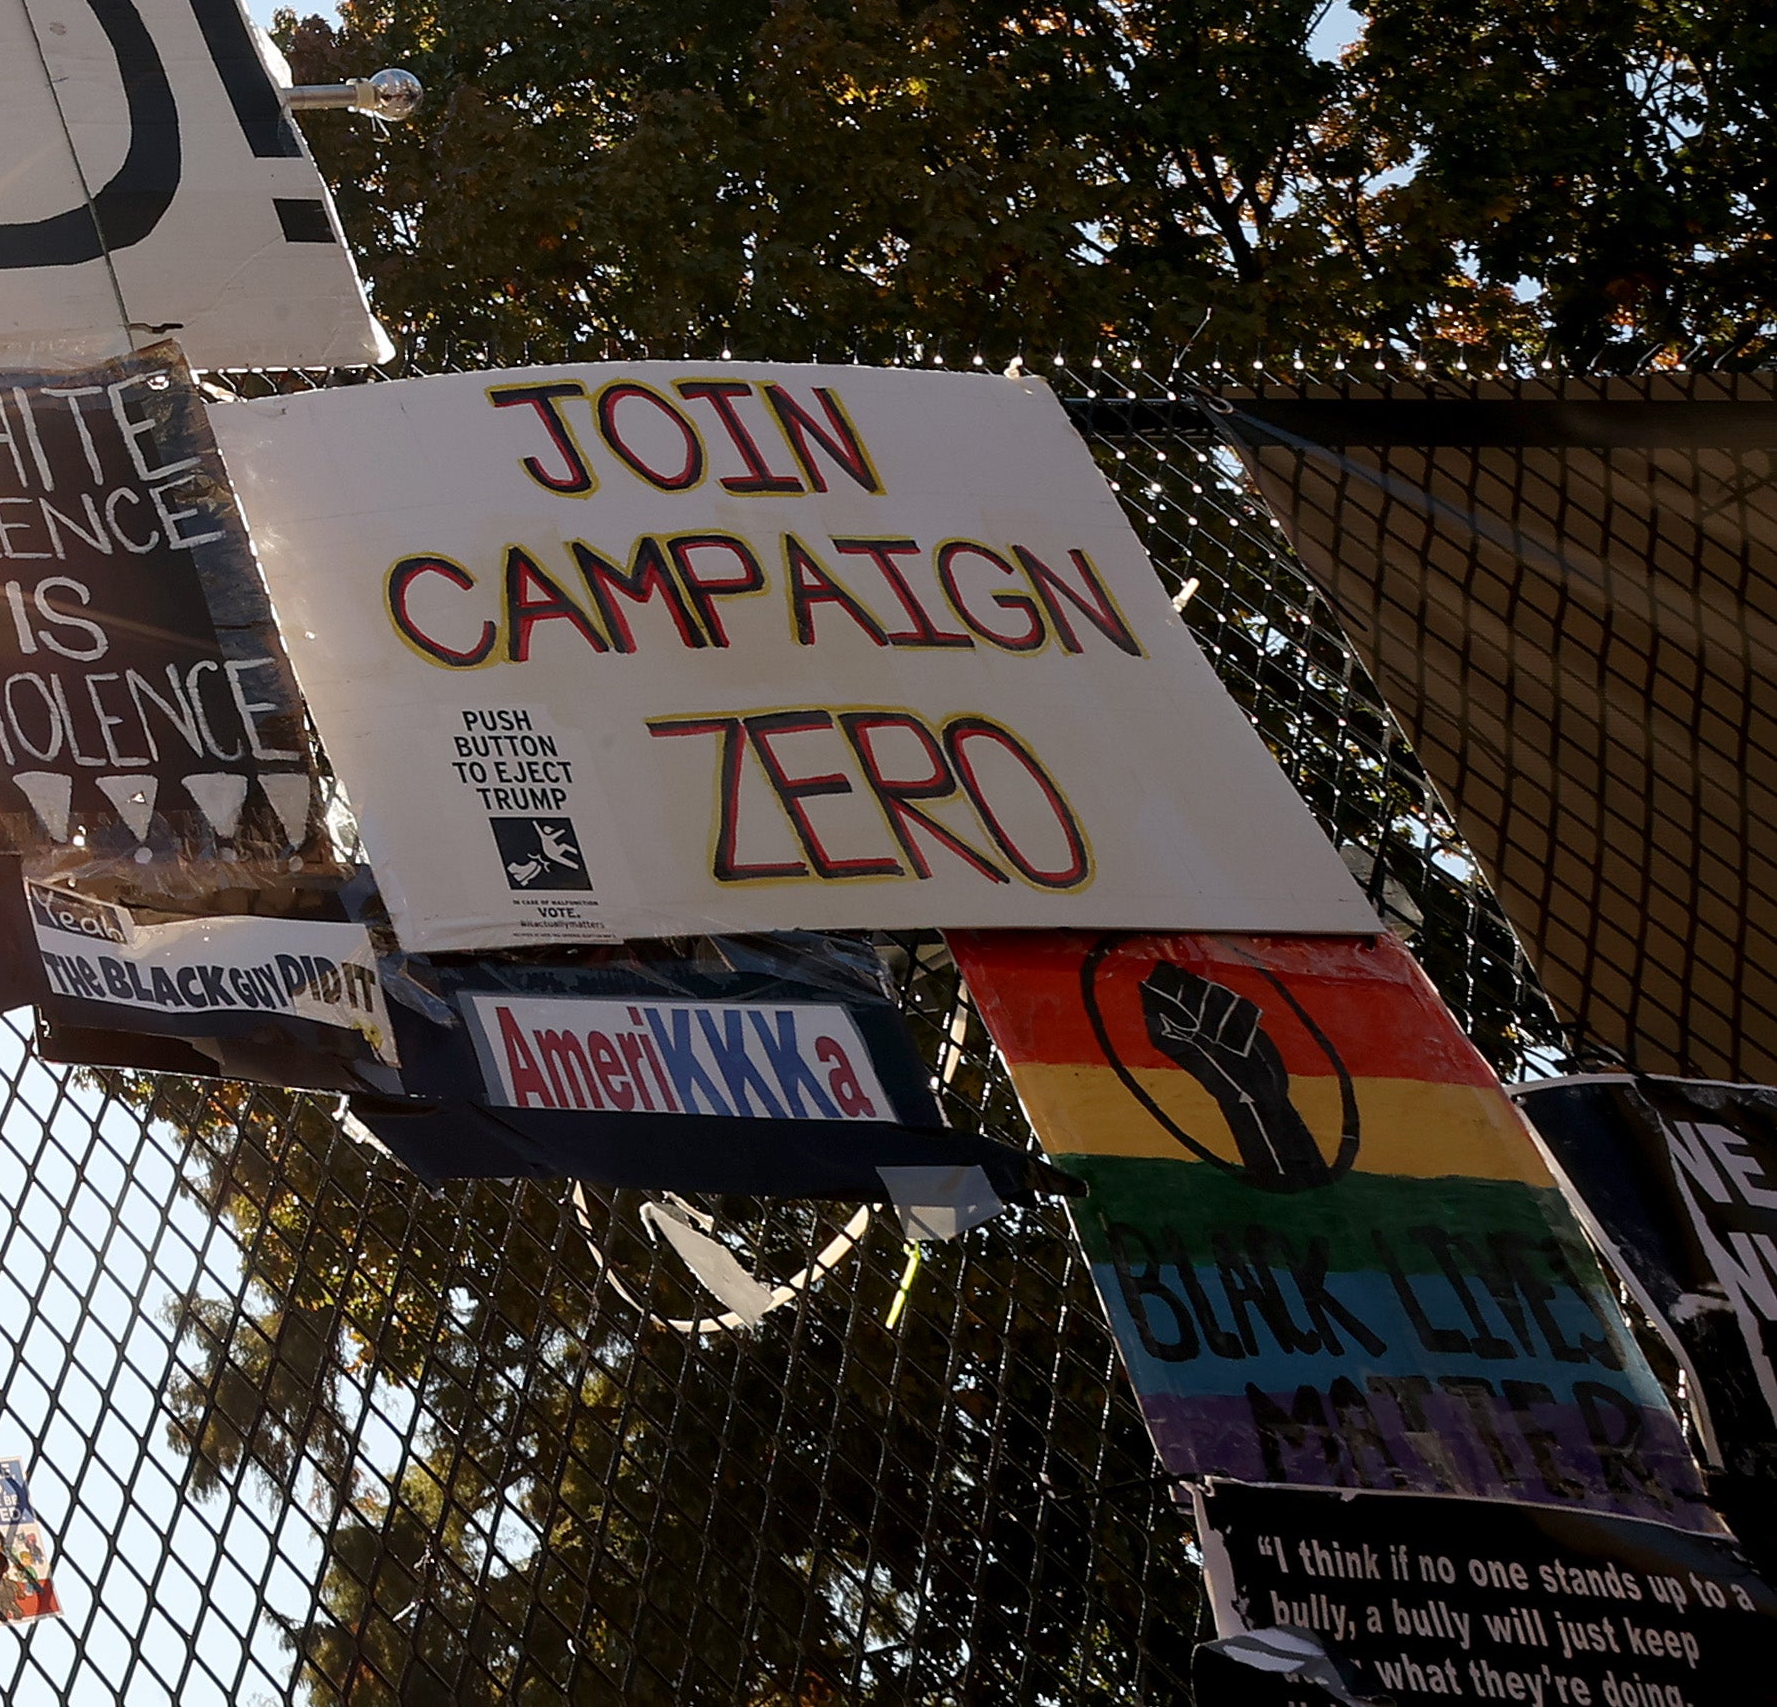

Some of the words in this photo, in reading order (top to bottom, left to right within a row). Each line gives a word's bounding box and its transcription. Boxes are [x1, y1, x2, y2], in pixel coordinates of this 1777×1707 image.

[484, 377, 887, 498] JOIN
[4, 575, 111, 663] IS
[381, 529, 1146, 670] CAMPAIGN
[454, 736, 558, 757] BUTTON
[462, 710, 533, 731] PUSH
[452, 762, 488, 783] TO
[494, 761, 574, 783] EJECT
[476, 788, 567, 810] TRUMP
[644, 704, 1093, 890] ZERO
[32, 885, 127, 942] Yeah
[537, 907, 581, 918] VOTE.
[98, 956, 239, 1008] BLACK
[227, 963, 289, 1010] GUY
[275, 954, 342, 1004] DID
[341, 963, 376, 1012] IT
[492, 1001, 878, 1121] AmeriKKKa
[1107, 1220, 1389, 1364] BLACK
[1370, 1226, 1629, 1372] LIVES
[1298, 1539, 1379, 1582] think
[1389, 1544, 1410, 1581] if
[1419, 1554, 1457, 1586] no
[1468, 1557, 1531, 1592] one
[1539, 1559, 1643, 1603] stands
[1646, 1574, 1686, 1614] up
[1690, 1572, 1726, 1610] to
[1729, 1581, 1757, 1613] a
[1269, 1590, 1356, 1641] bully,
[1393, 1597, 1471, 1649] bully
[1482, 1608, 1548, 1648] will
[1556, 1611, 1617, 1659] just
[1629, 1614, 1700, 1669] keep
[1377, 1656, 1458, 1695] what
[1468, 1659, 1591, 1707] they're
